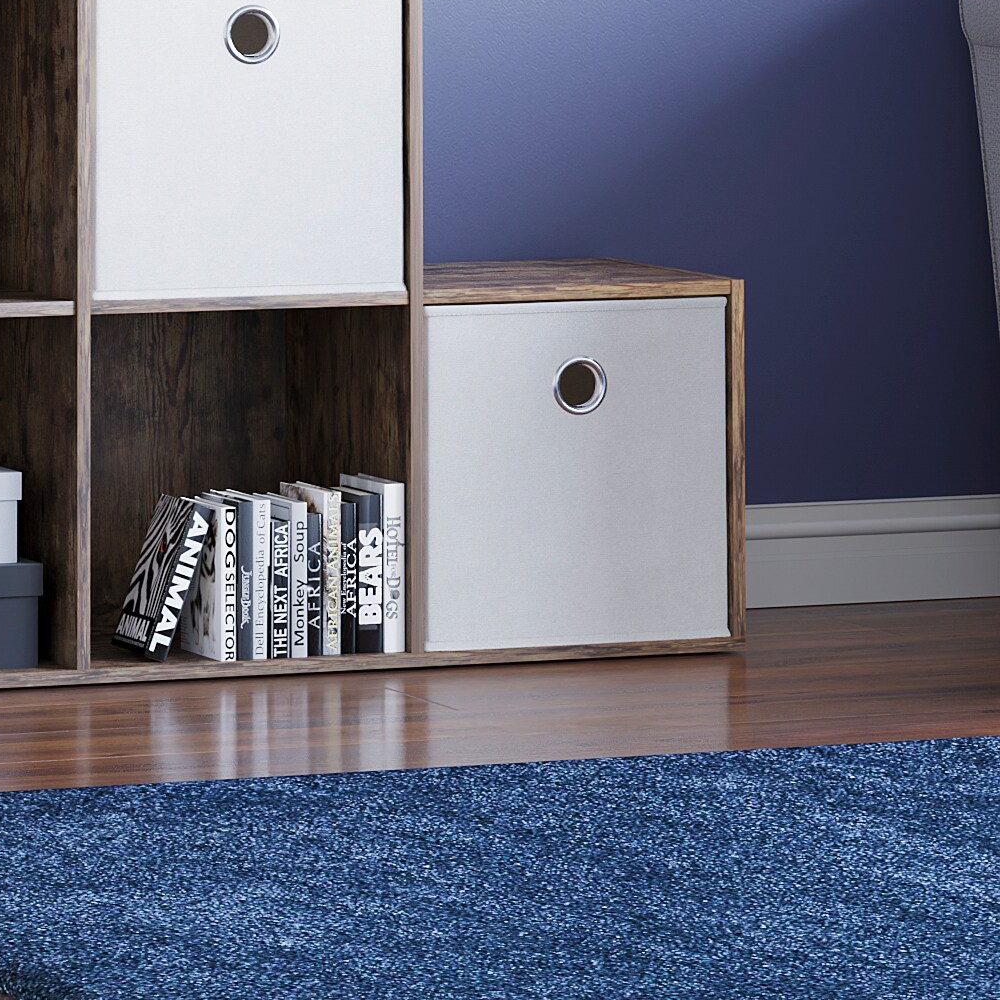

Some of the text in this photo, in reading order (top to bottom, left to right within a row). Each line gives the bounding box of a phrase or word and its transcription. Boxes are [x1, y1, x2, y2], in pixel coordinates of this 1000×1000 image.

[115, 613, 150, 642] ANIMAL
[148, 510, 209, 653] ANIMAL
[224, 508, 236, 661] DOG SELECTOR
[255, 503, 267, 656] Dell Encyclopedia of Cats
[273, 523, 289, 658] THE NEXT AFRICA
[293, 520, 308, 646] Monkey Soup
[307, 541, 321, 629] AFRICA
[326, 491, 340, 650] AFRICAN ANIMALS
[346, 537, 357, 618] AFRICA
[358, 527, 383, 625] BEARS
